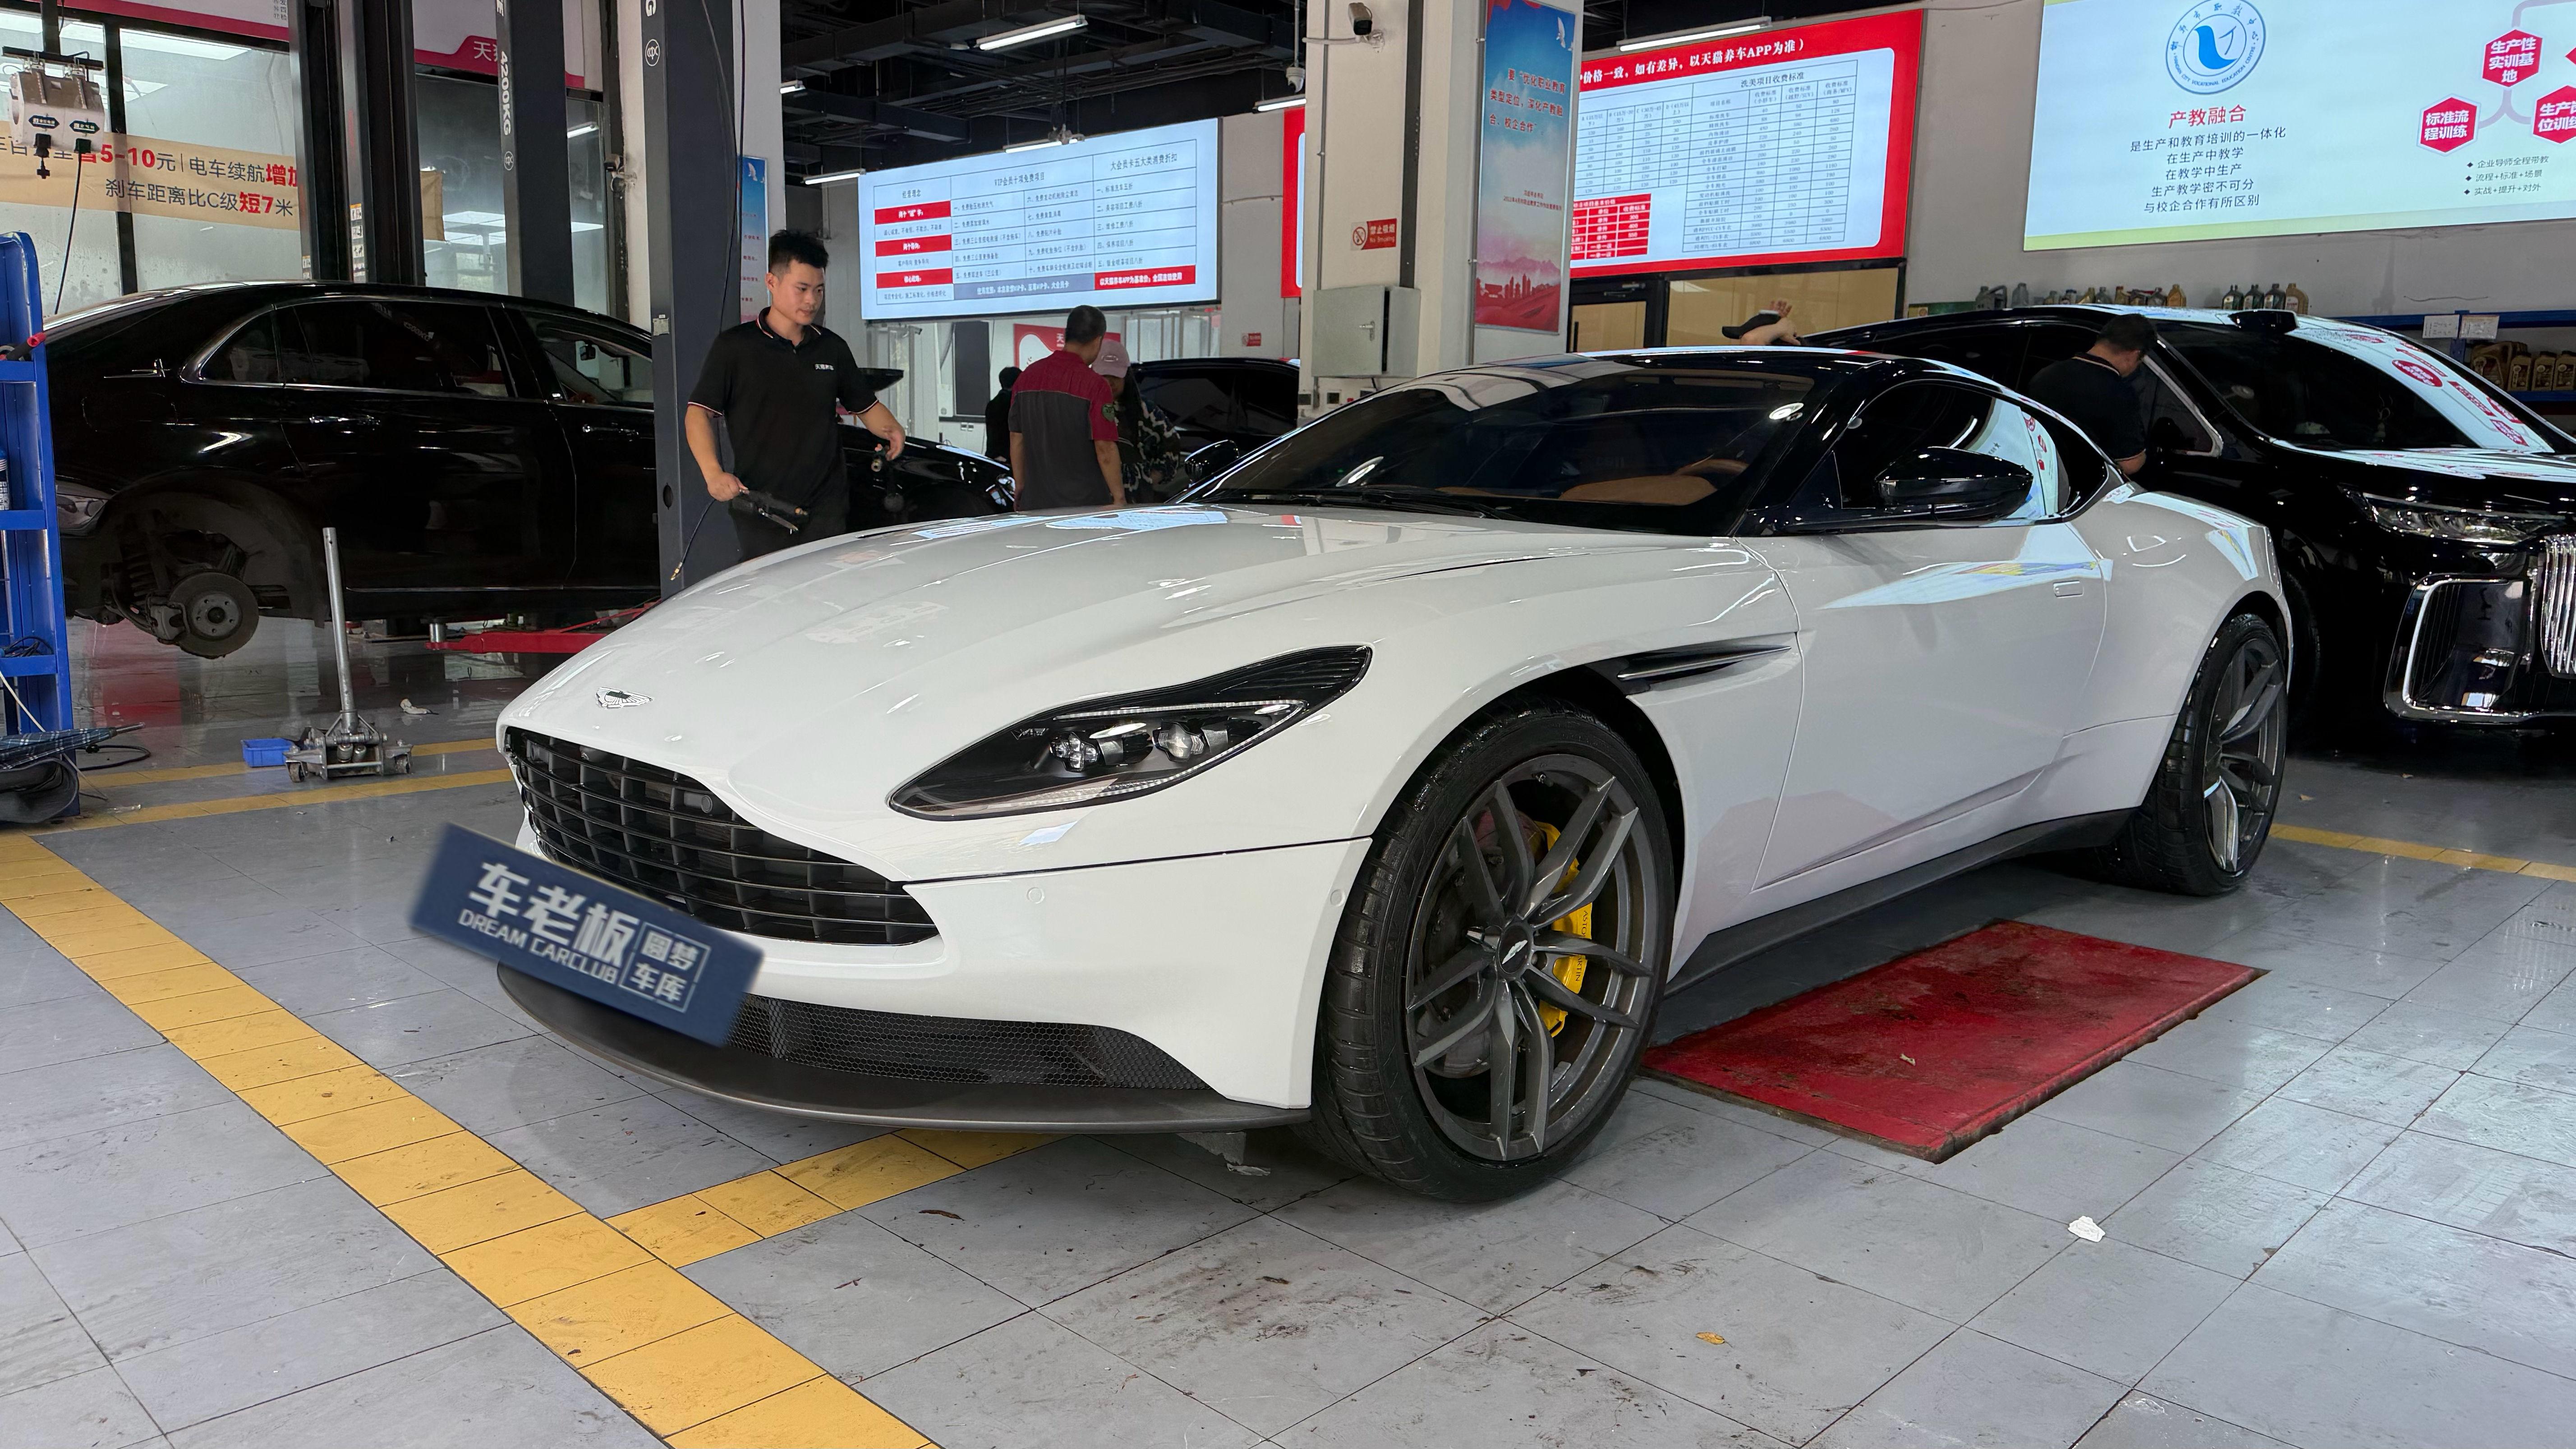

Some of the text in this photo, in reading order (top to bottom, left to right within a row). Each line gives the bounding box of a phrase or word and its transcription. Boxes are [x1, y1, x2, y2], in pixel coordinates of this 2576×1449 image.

[2490, 37, 2536, 55] 生产性
[1579, 38, 1804, 85] 价格一致，如有差异，以天猫养车APP为准）
[2489, 52, 2534, 70] 实训基
[1741, 71, 1804, 88] 洗美项目收费标准
[2222, 65, 2245, 83] EDUCATION
[2502, 69, 2518, 83] 地
[501, 51, 511, 135] 4200KG
[2168, 104, 2247, 129] 产教融合
[2426, 110, 2469, 126] 标准流
[2130, 126, 2286, 152] 是生产和教育培训的一体化
[2424, 125, 2467, 141] 程训练
[1110, 153, 1178, 171] 大会员卡五大类消费折扣
[2167, 147, 2244, 164] 在生产中教学
[2477, 156, 2549, 169] 企业导师全程带教
[994, 172, 1045, 186] VIP会员十项免费项目
[2166, 163, 2242, 180] 在教学中生产
[2152, 179, 2254, 197] 生产教学密不可分
[105, 179, 293, 216] 刹车距离比C级短7米
[2144, 194, 2259, 213] 与校企合作有所区别
